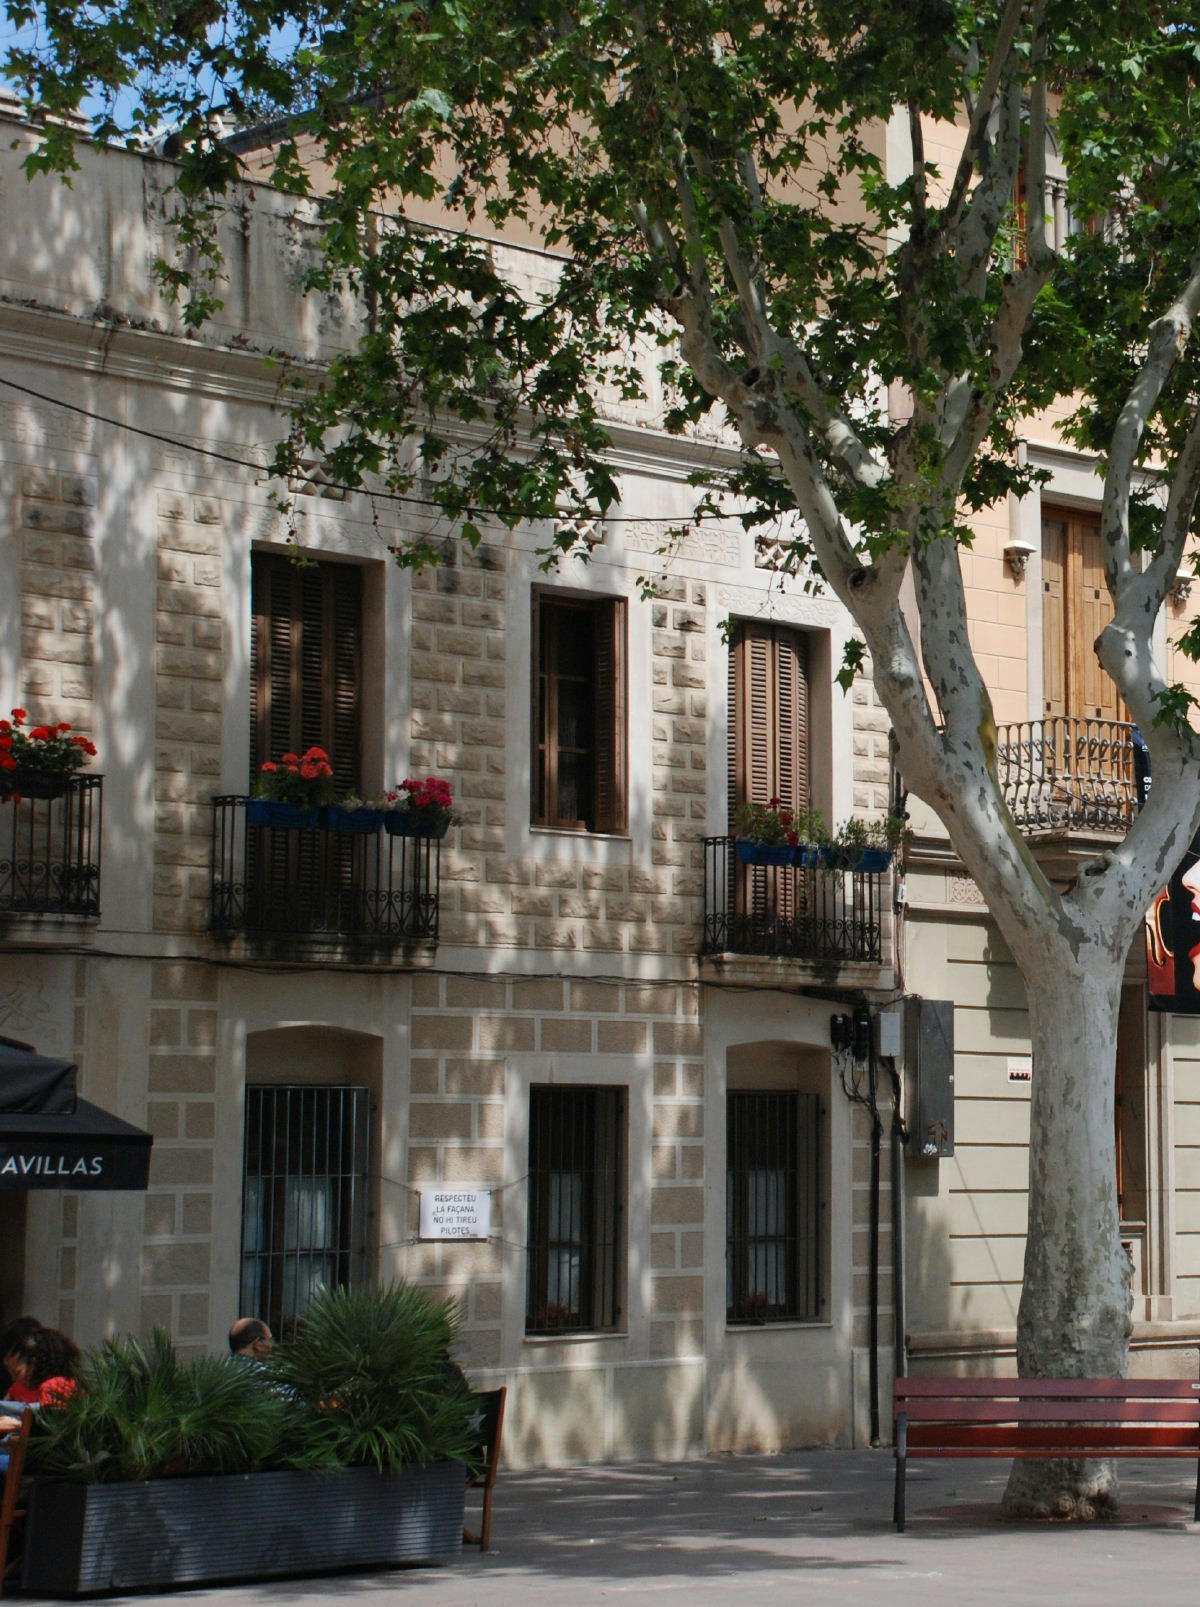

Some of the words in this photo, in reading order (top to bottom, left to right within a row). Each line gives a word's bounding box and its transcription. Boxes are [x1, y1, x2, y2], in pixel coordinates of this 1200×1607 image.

[434, 1194, 477, 1202] RESPECTEU
[436, 1205, 445, 1213] LA
[447, 1205, 475, 1214] FAÇANA
[433, 1216, 444, 1224] NO
[446, 1216, 454, 1224] HI
[456, 1216, 477, 1224] TIREU
[440, 1226, 470, 1235] PILOTES
